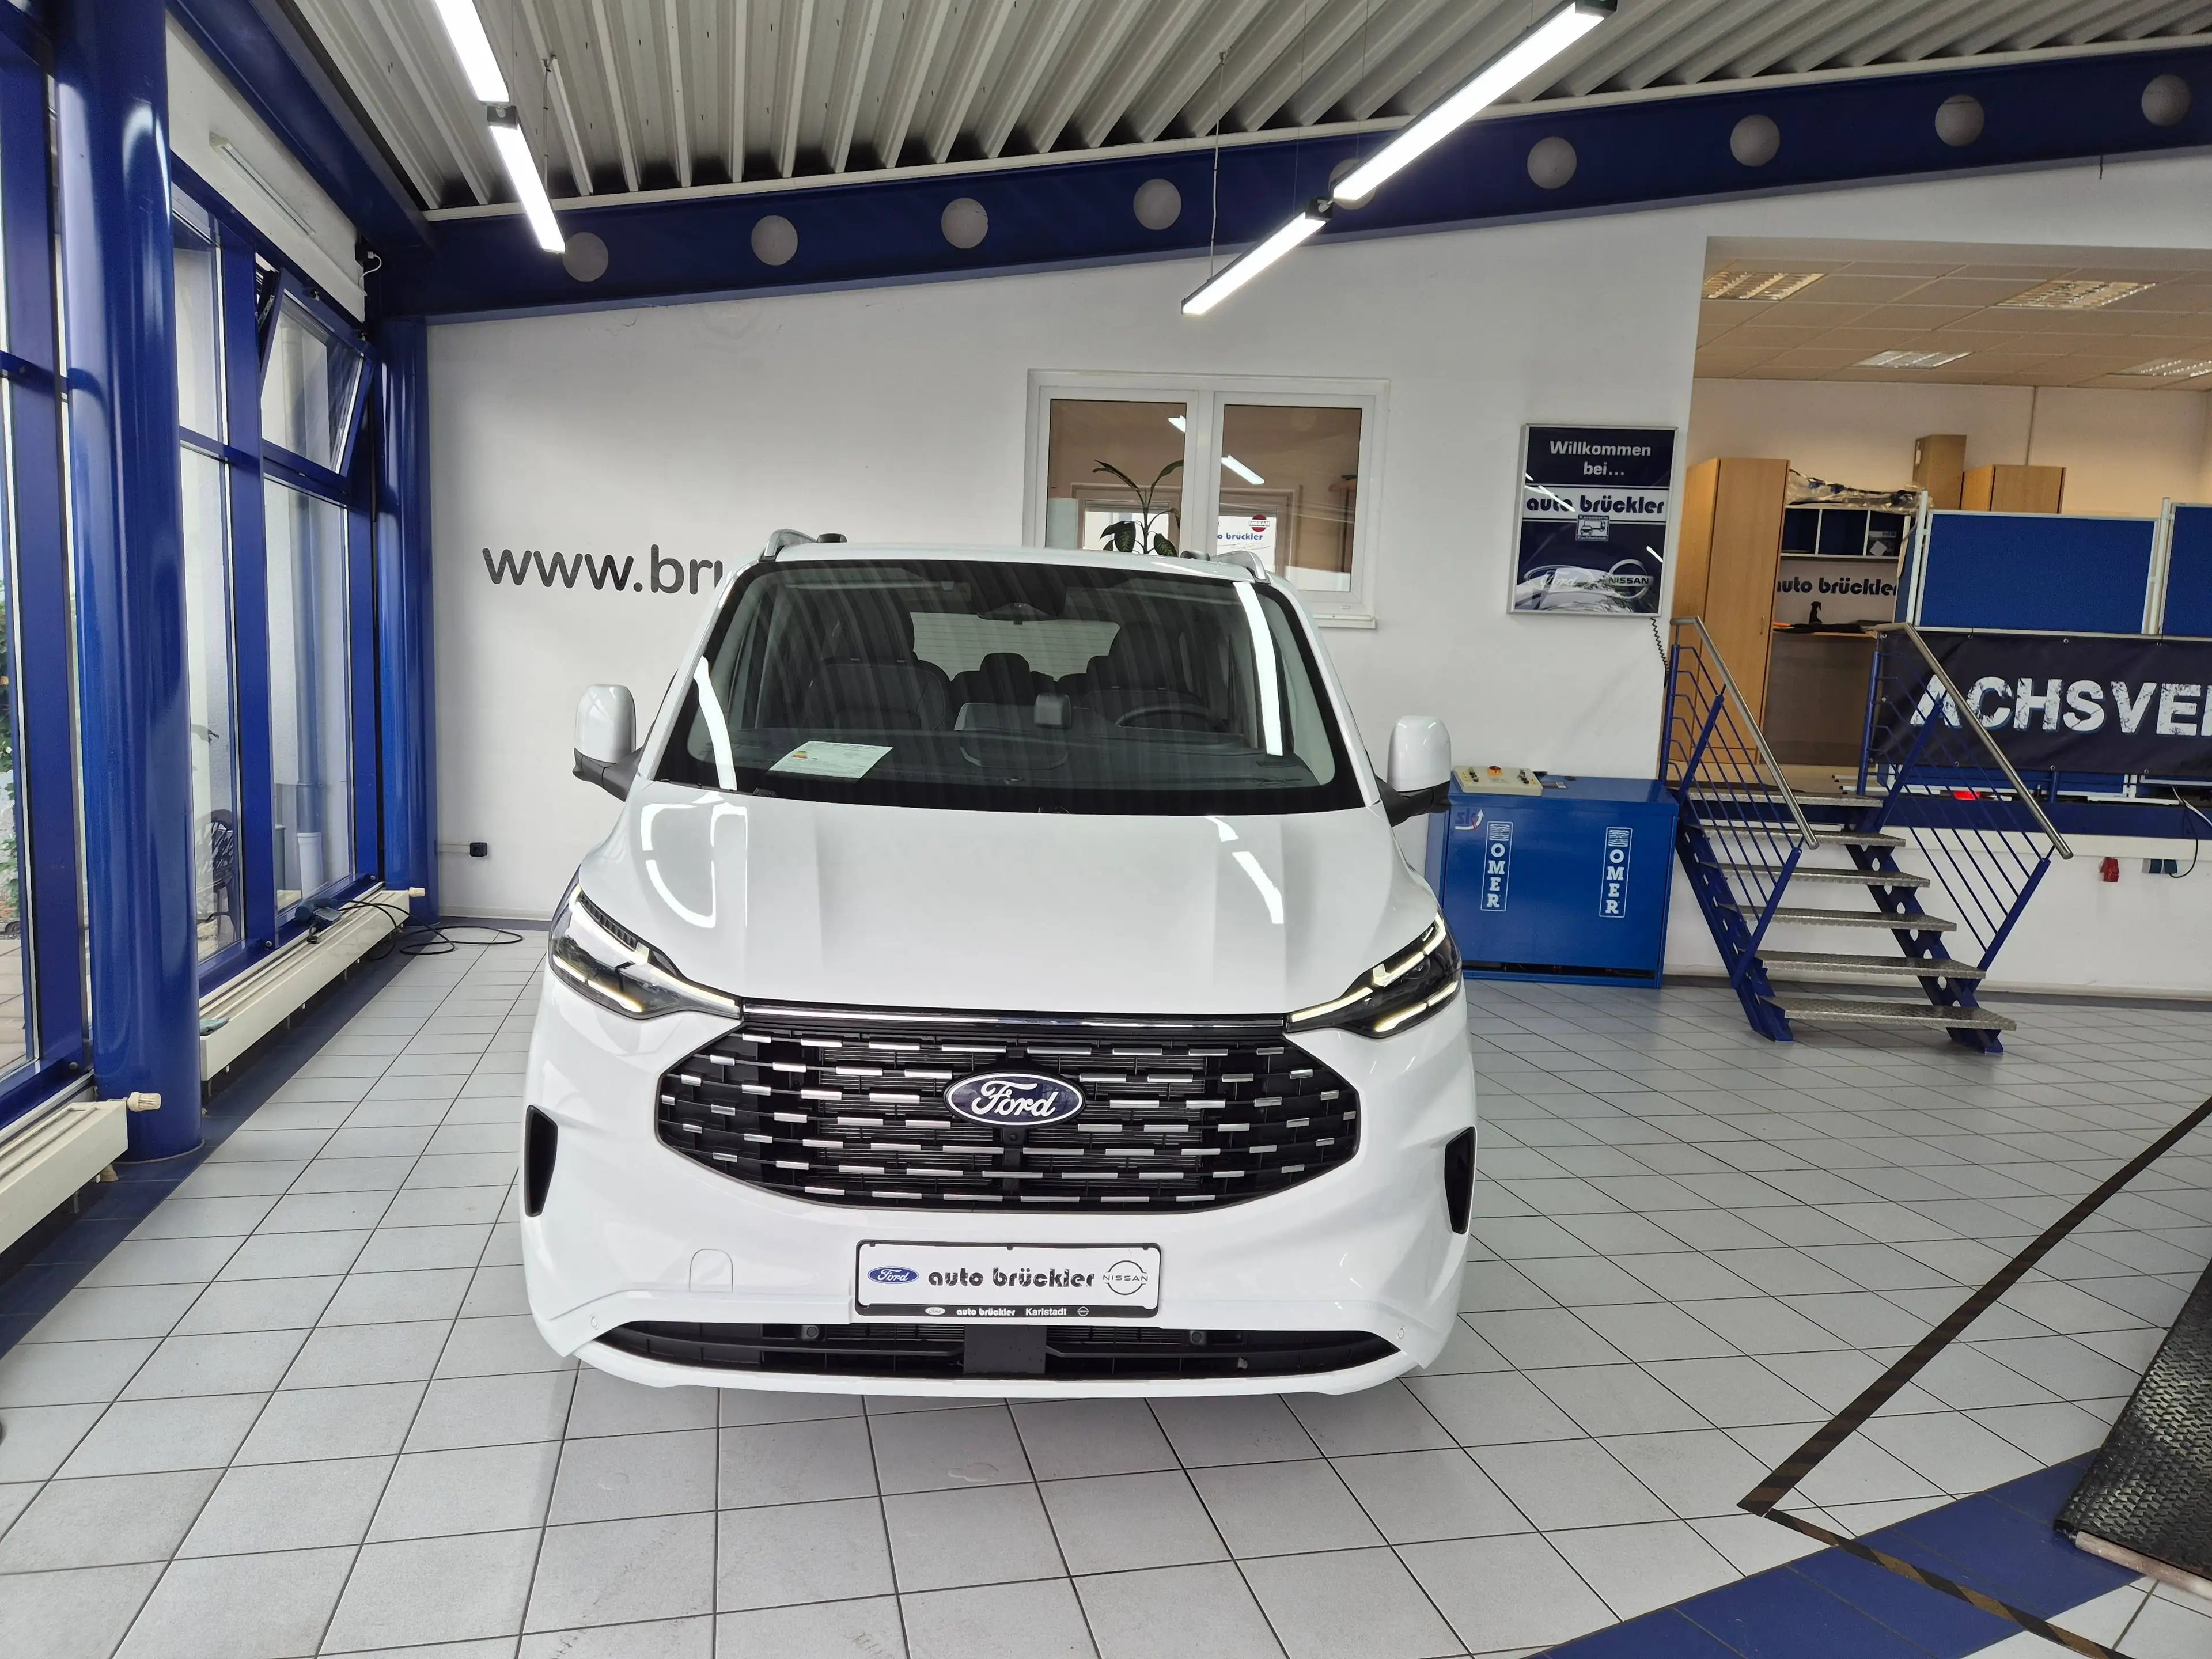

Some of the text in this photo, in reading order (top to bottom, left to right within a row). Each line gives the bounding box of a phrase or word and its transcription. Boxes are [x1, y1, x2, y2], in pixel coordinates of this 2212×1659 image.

[1550, 441, 1651, 456] Willkommen
[1584, 462, 1624, 476] bei...
[1527, 495, 1664, 513] auto brückler
[1226, 532, 1263, 540] brückler
[1540, 569, 1577, 586] Ford
[1609, 577, 1649, 585] NISSAN
[1910, 674, 2212, 737] ACHSVE
[1486, 843, 1506, 908] OMER
[1605, 849, 1625, 915] OMER
[971, 1080, 1059, 1116] Ford
[876, 1266, 910, 1283] Ford
[927, 1267, 984, 1287] auto
[993, 1268, 1095, 1287] brückler
[979, 1308, 1016, 1316] brückler
[1025, 1308, 1067, 1316] Karlstadt
